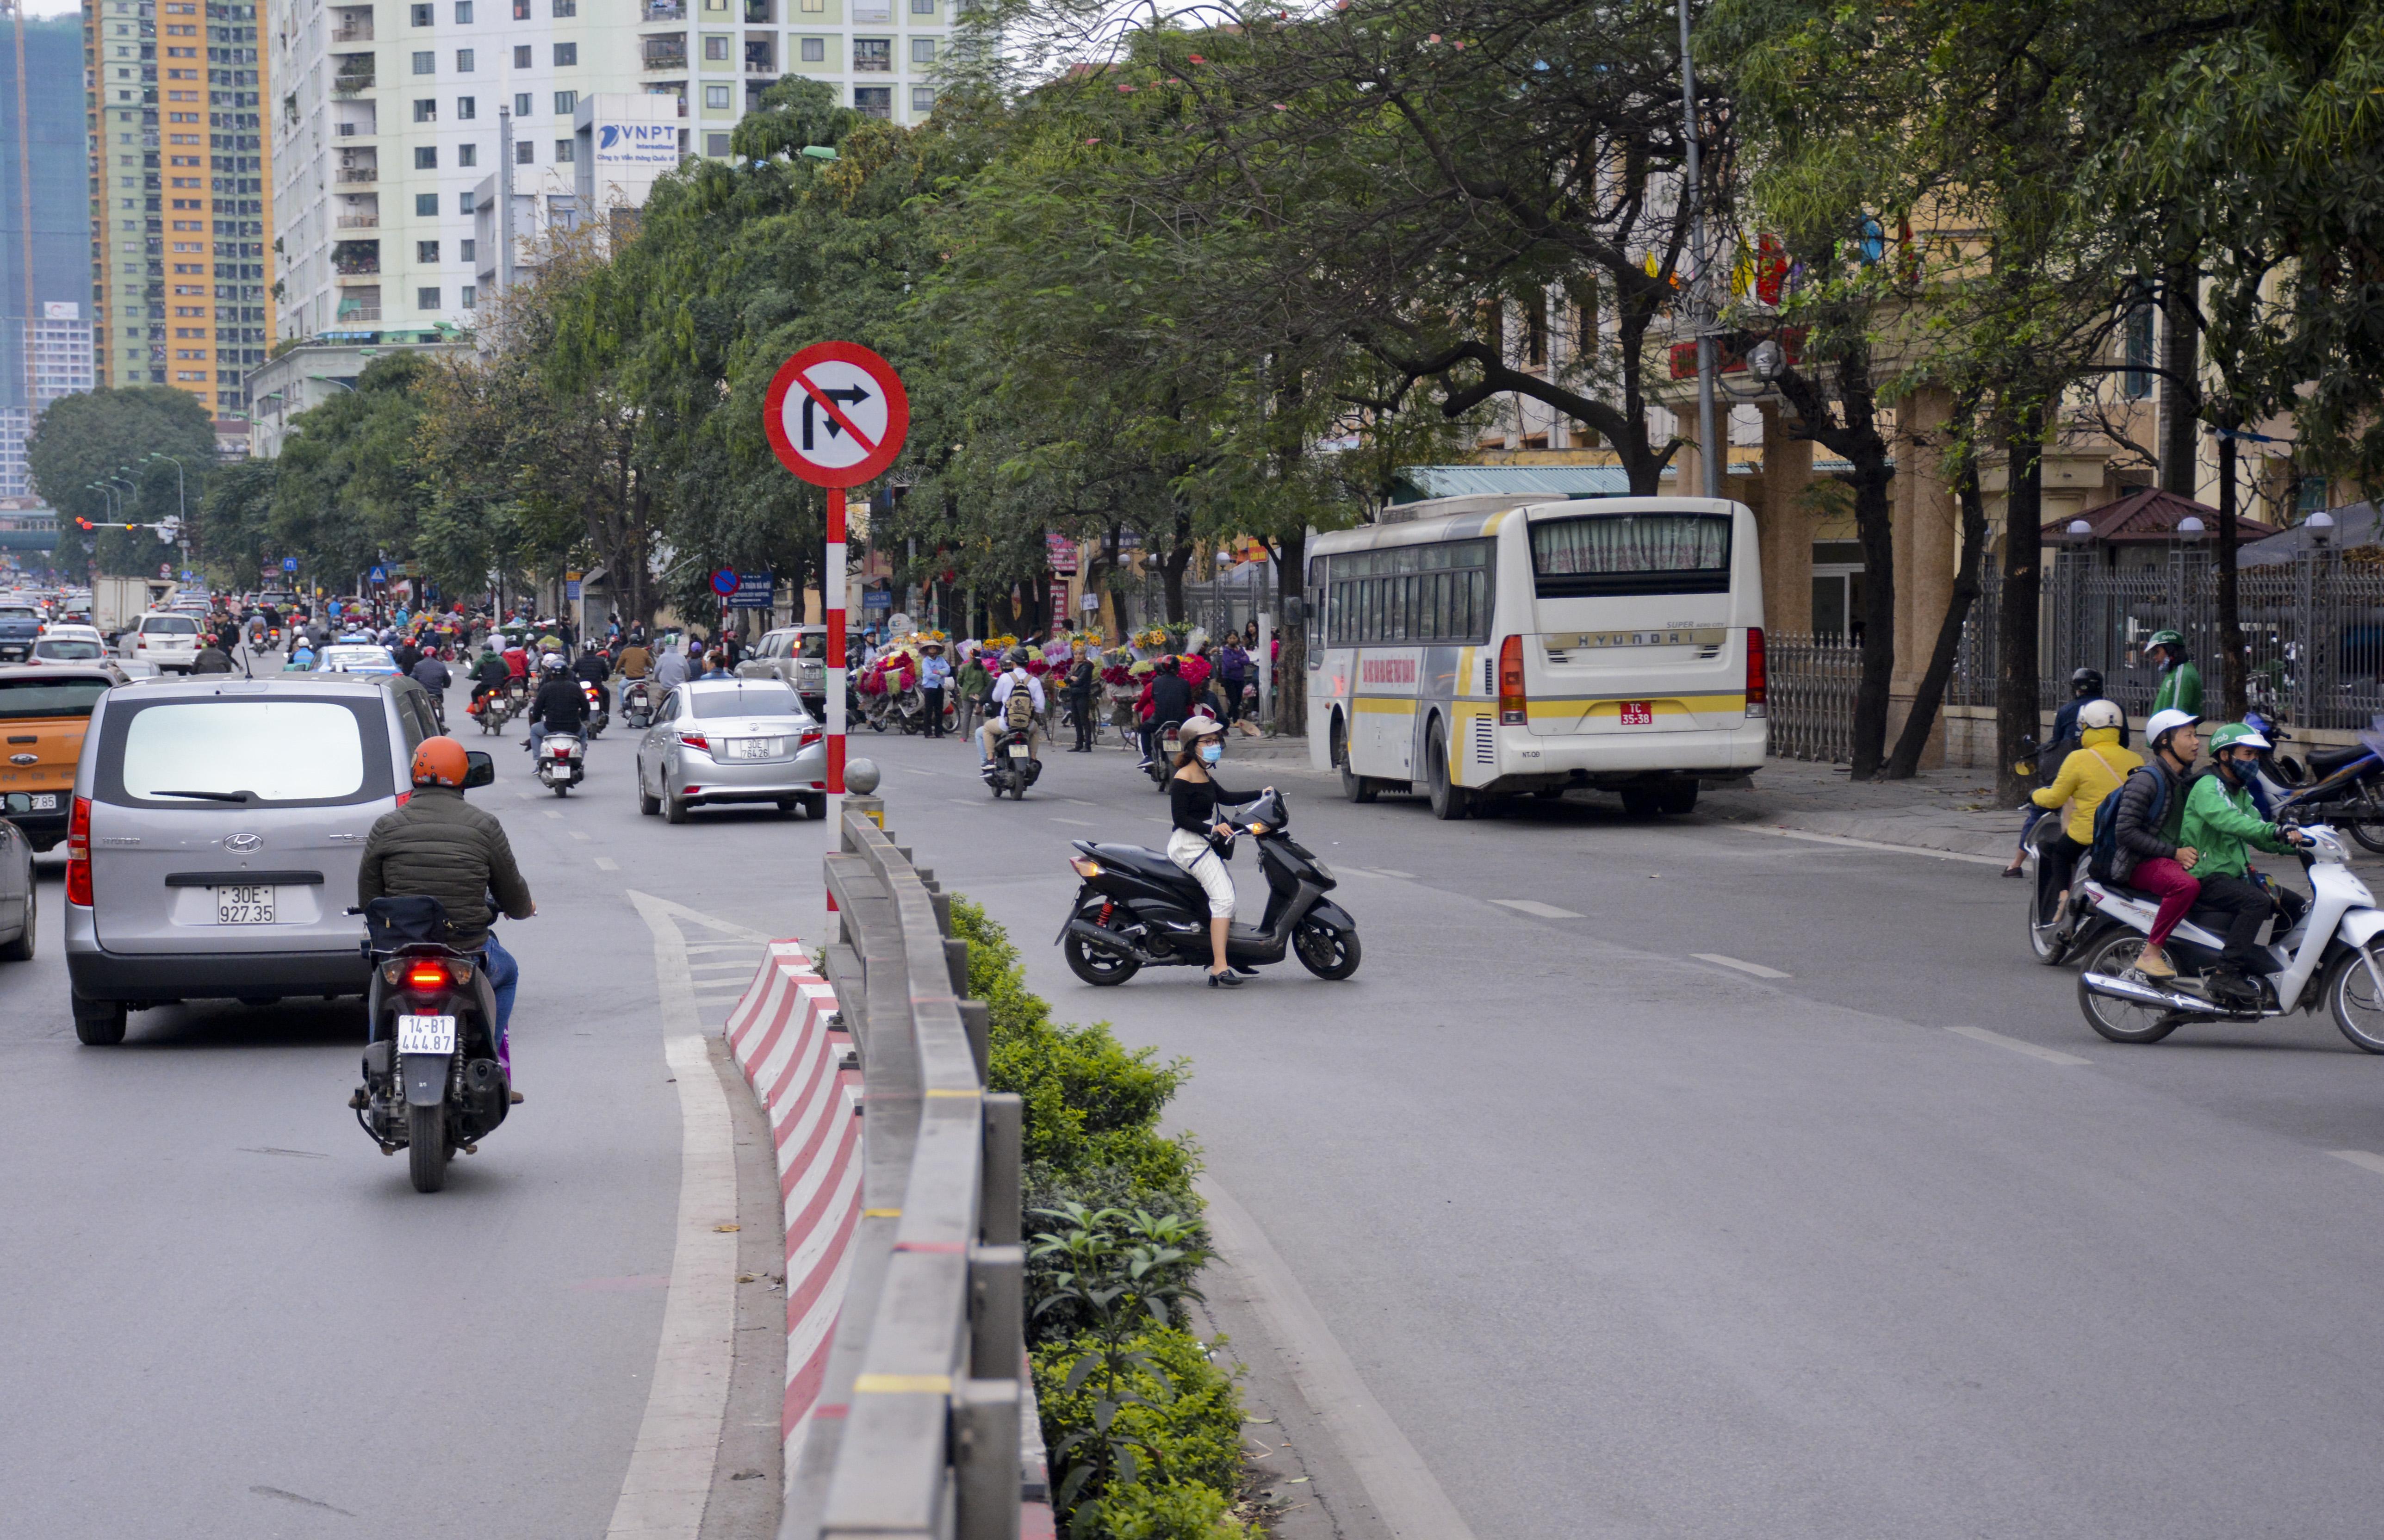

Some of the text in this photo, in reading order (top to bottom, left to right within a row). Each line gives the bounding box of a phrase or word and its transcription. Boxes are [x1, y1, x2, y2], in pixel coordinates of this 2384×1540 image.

[622, 126, 675, 139] VNPT
[1578, 633, 1693, 646] HYUNDAI
[1629, 703, 1641, 713] TC
[1623, 714, 1650, 724] 35-38
[2211, 733, 2229, 746] Grab
[742, 749, 768, 758] 764.26
[232, 887, 261, 904] 30E
[220, 906, 273, 922] 927.35
[410, 1019, 445, 1034] 14-B1
[402, 1035, 450, 1051] 444.87
